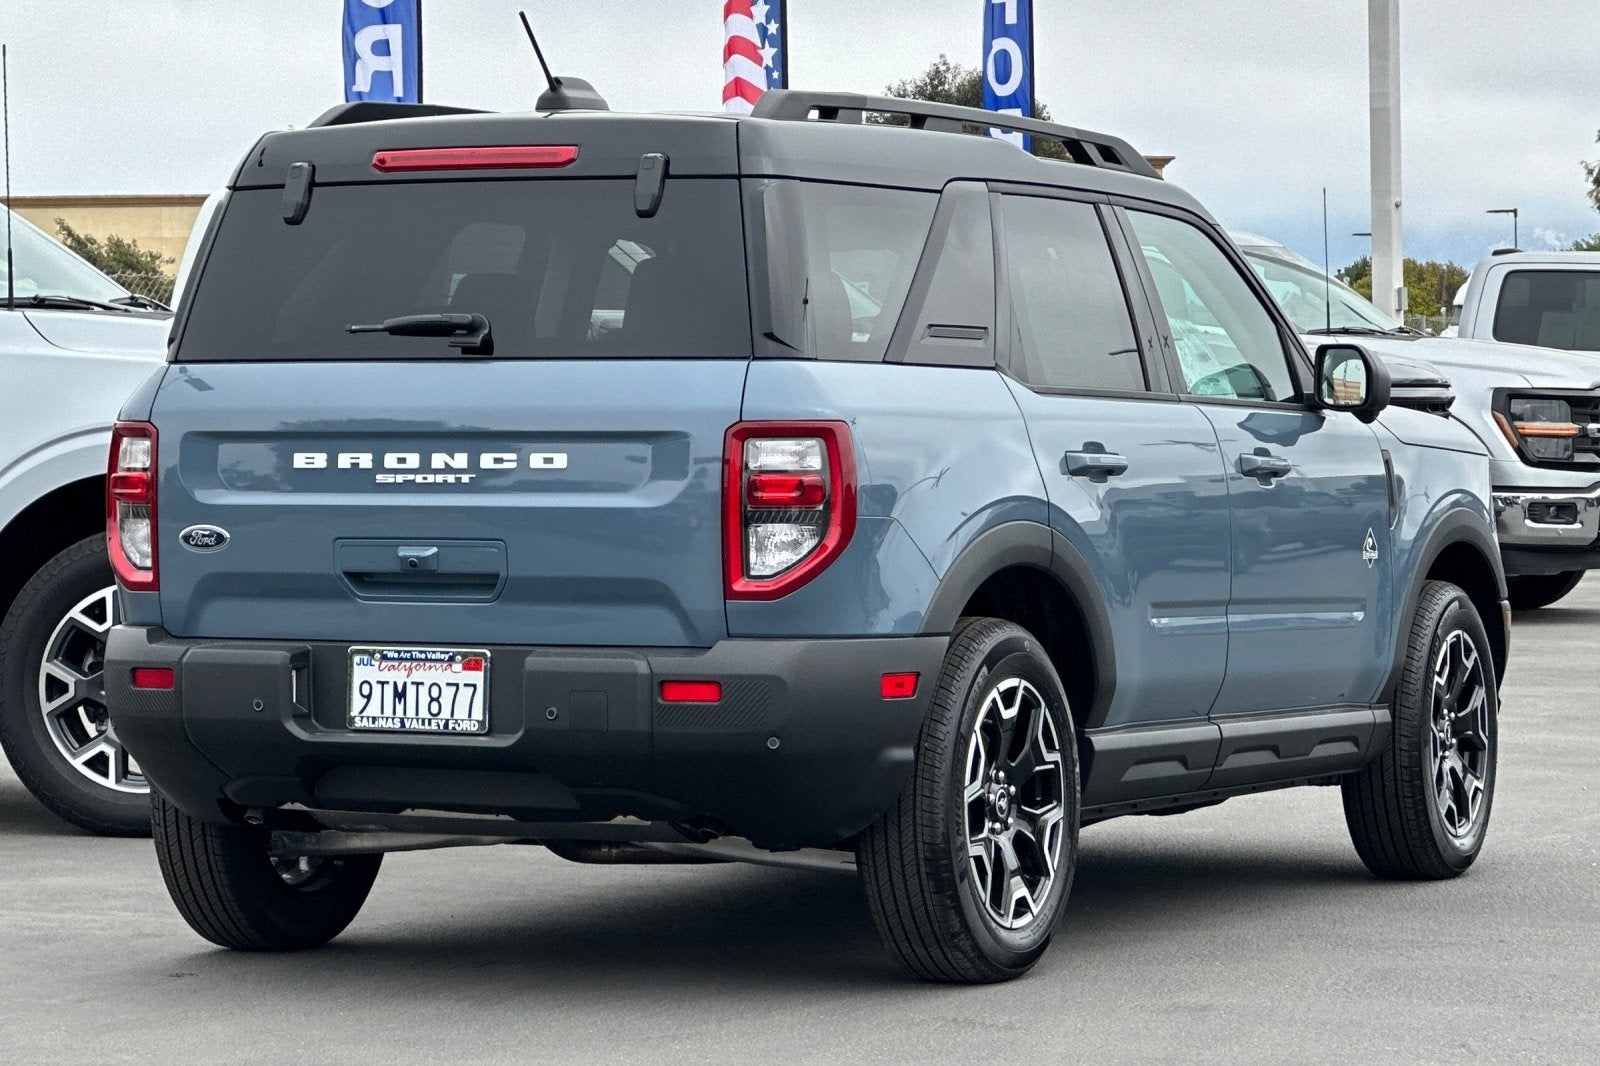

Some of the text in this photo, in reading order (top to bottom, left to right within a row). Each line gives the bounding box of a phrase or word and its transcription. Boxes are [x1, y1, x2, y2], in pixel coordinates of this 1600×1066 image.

[293, 452, 568, 469] BRONCO
[375, 474, 476, 483] SPORT
[189, 529, 217, 545] Ford
[356, 656, 376, 667] JUL
[399, 651, 411, 659] Are
[411, 651, 426, 659] The
[378, 660, 462, 678] California
[358, 680, 478, 719] 9TMT877
[354, 716, 479, 731] SALINAS VALLEY FORD
